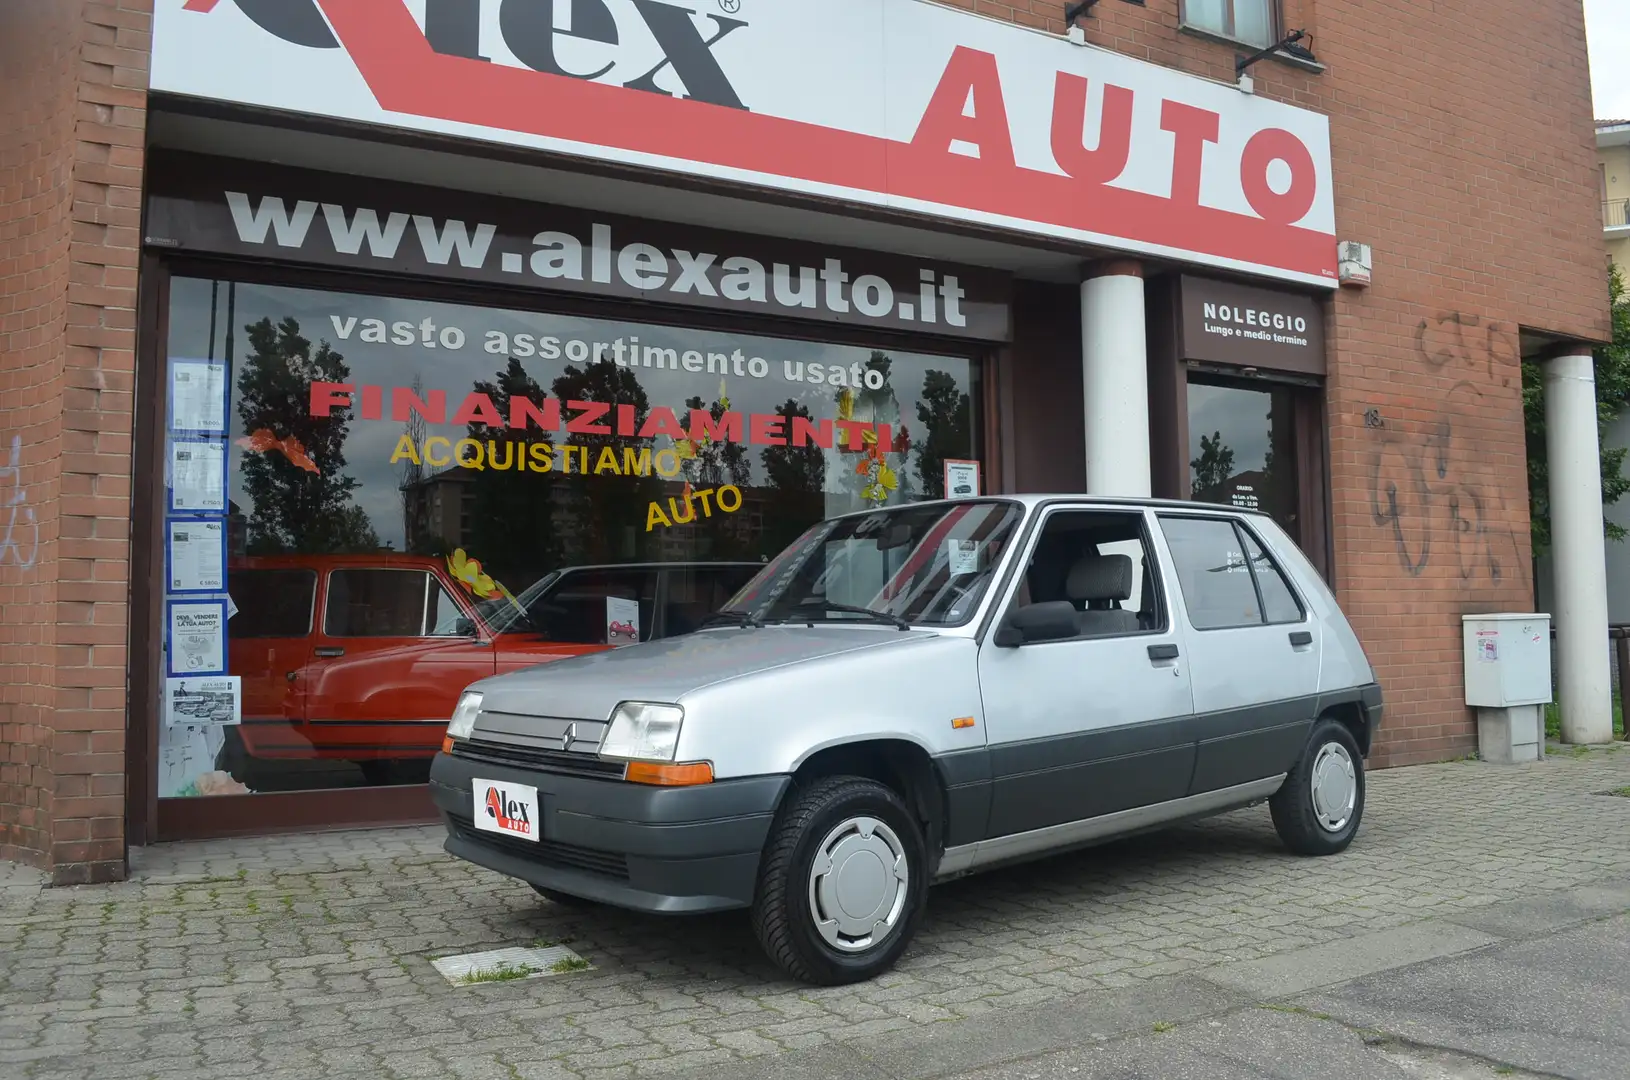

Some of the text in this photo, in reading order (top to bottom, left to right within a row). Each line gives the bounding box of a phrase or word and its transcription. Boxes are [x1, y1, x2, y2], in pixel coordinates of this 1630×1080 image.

[910, 44, 1317, 226] AUTO
[225, 191, 966, 327] www.alexauto.it
[1203, 302, 1306, 333] NOLEGGIO
[1204, 322, 1308, 346] Lungo e medio termine
[330, 315, 885, 391] vasto assortimento usato
[310, 381, 894, 453] FINANZIAMENTI
[390, 434, 681, 478] ACQUISTIAMO
[645, 484, 743, 532] AUTO
[485, 787, 530, 824] Alex
[508, 819, 530, 832] AUTO
